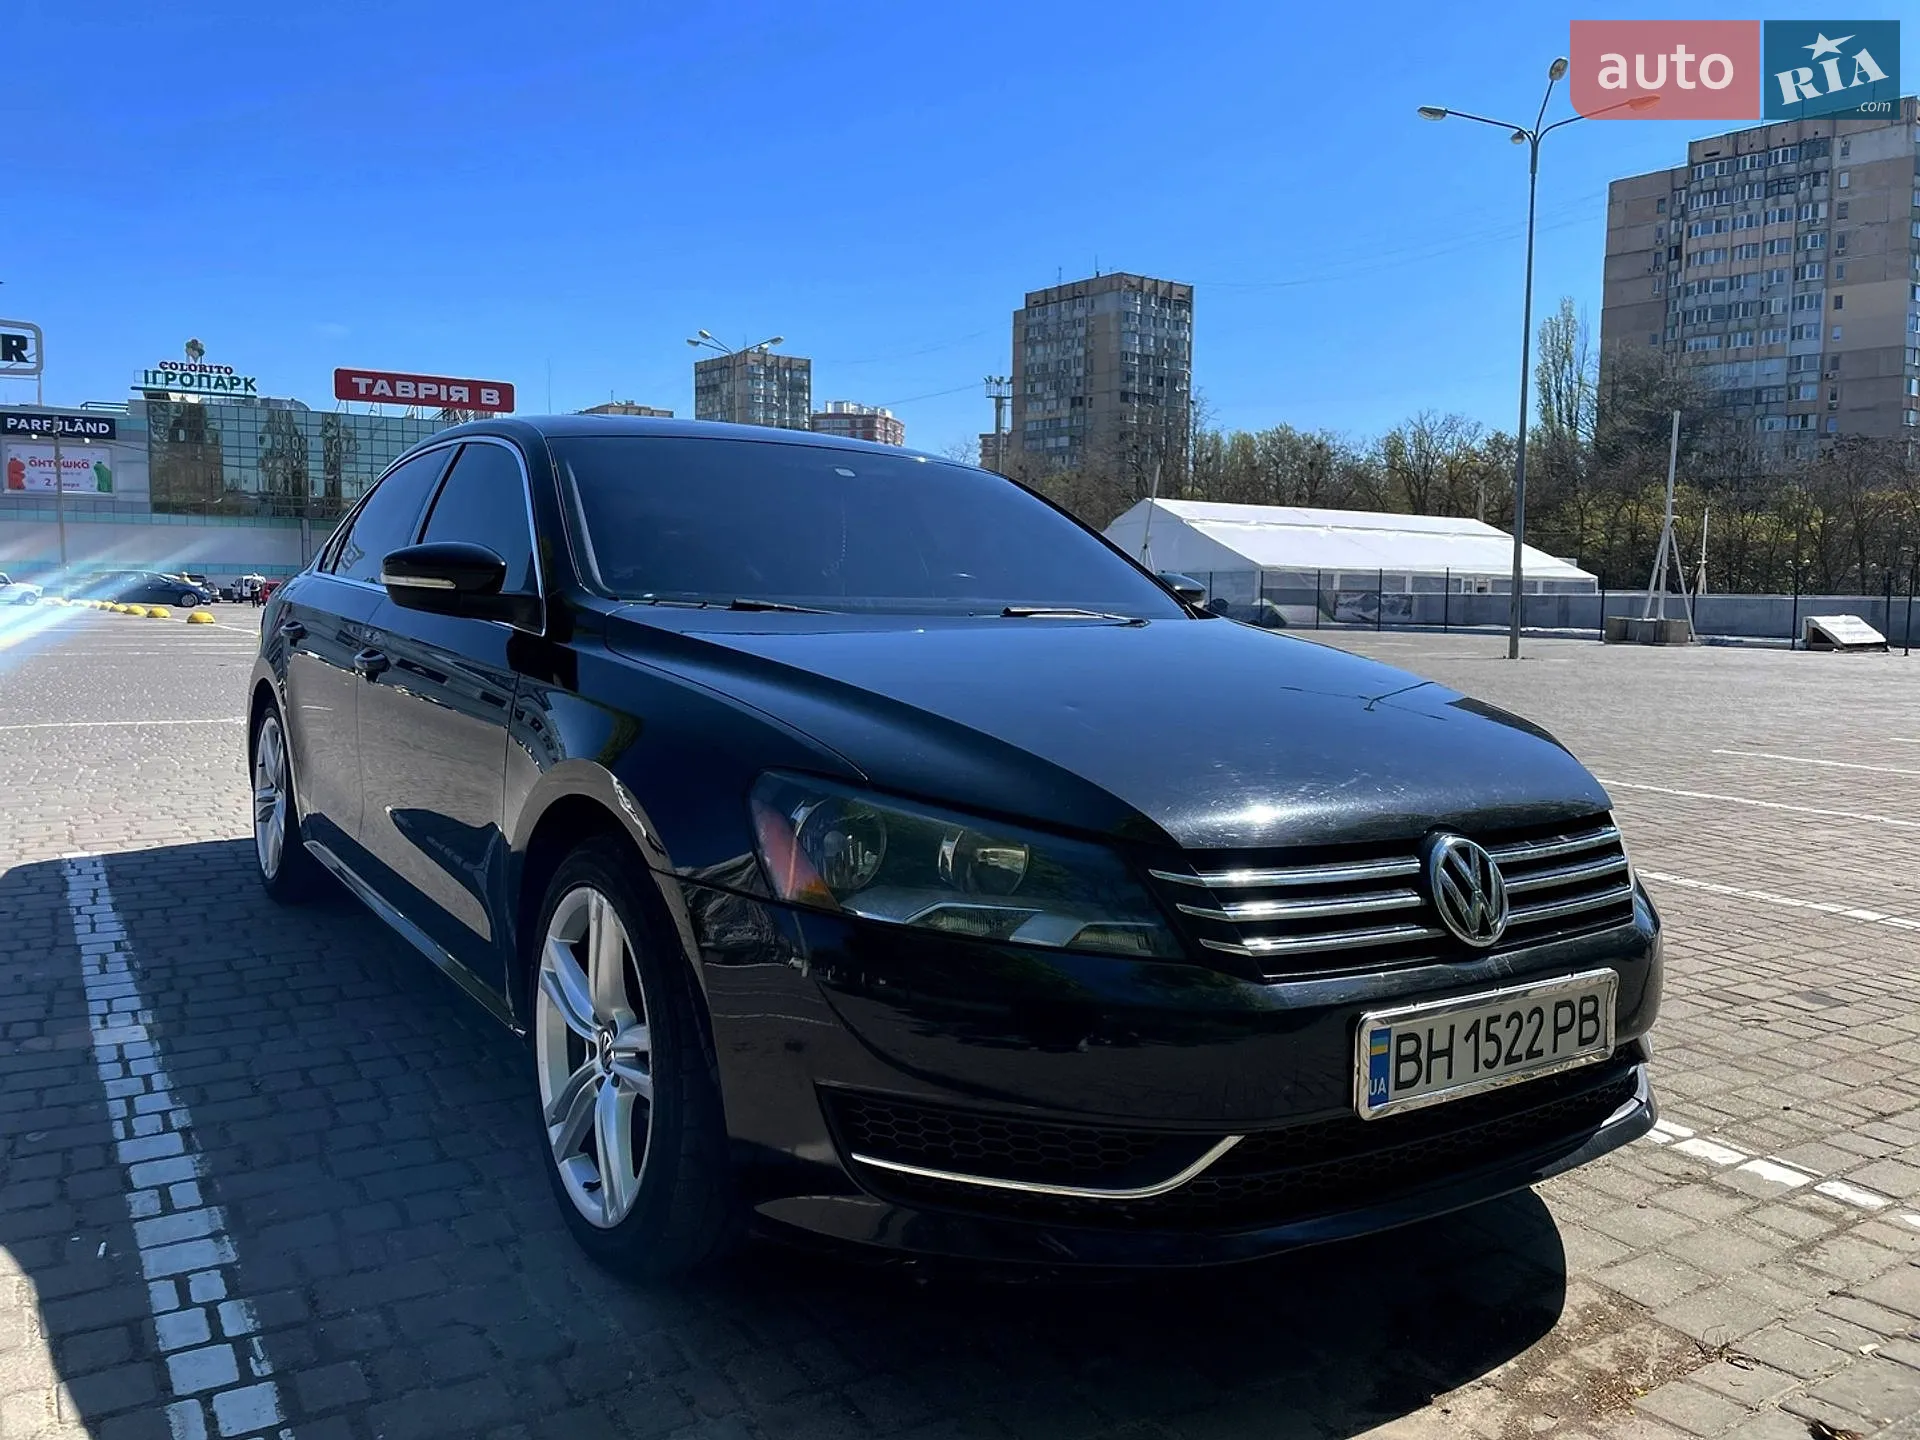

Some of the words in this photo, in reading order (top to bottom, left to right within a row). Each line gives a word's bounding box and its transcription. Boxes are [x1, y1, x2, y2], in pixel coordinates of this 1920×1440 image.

[158, 361, 234, 376] COLORITO
[144, 369, 257, 392] ІГРОПАРК
[351, 377, 470, 404] ТАВРІЯ
[480, 387, 501, 406] В
[28, 457, 90, 469] антшка
[1393, 1024, 1456, 1091] BH
[1463, 1006, 1545, 1074] 1522
[1552, 994, 1600, 1054] PB
[1369, 1079, 1387, 1096] UA
